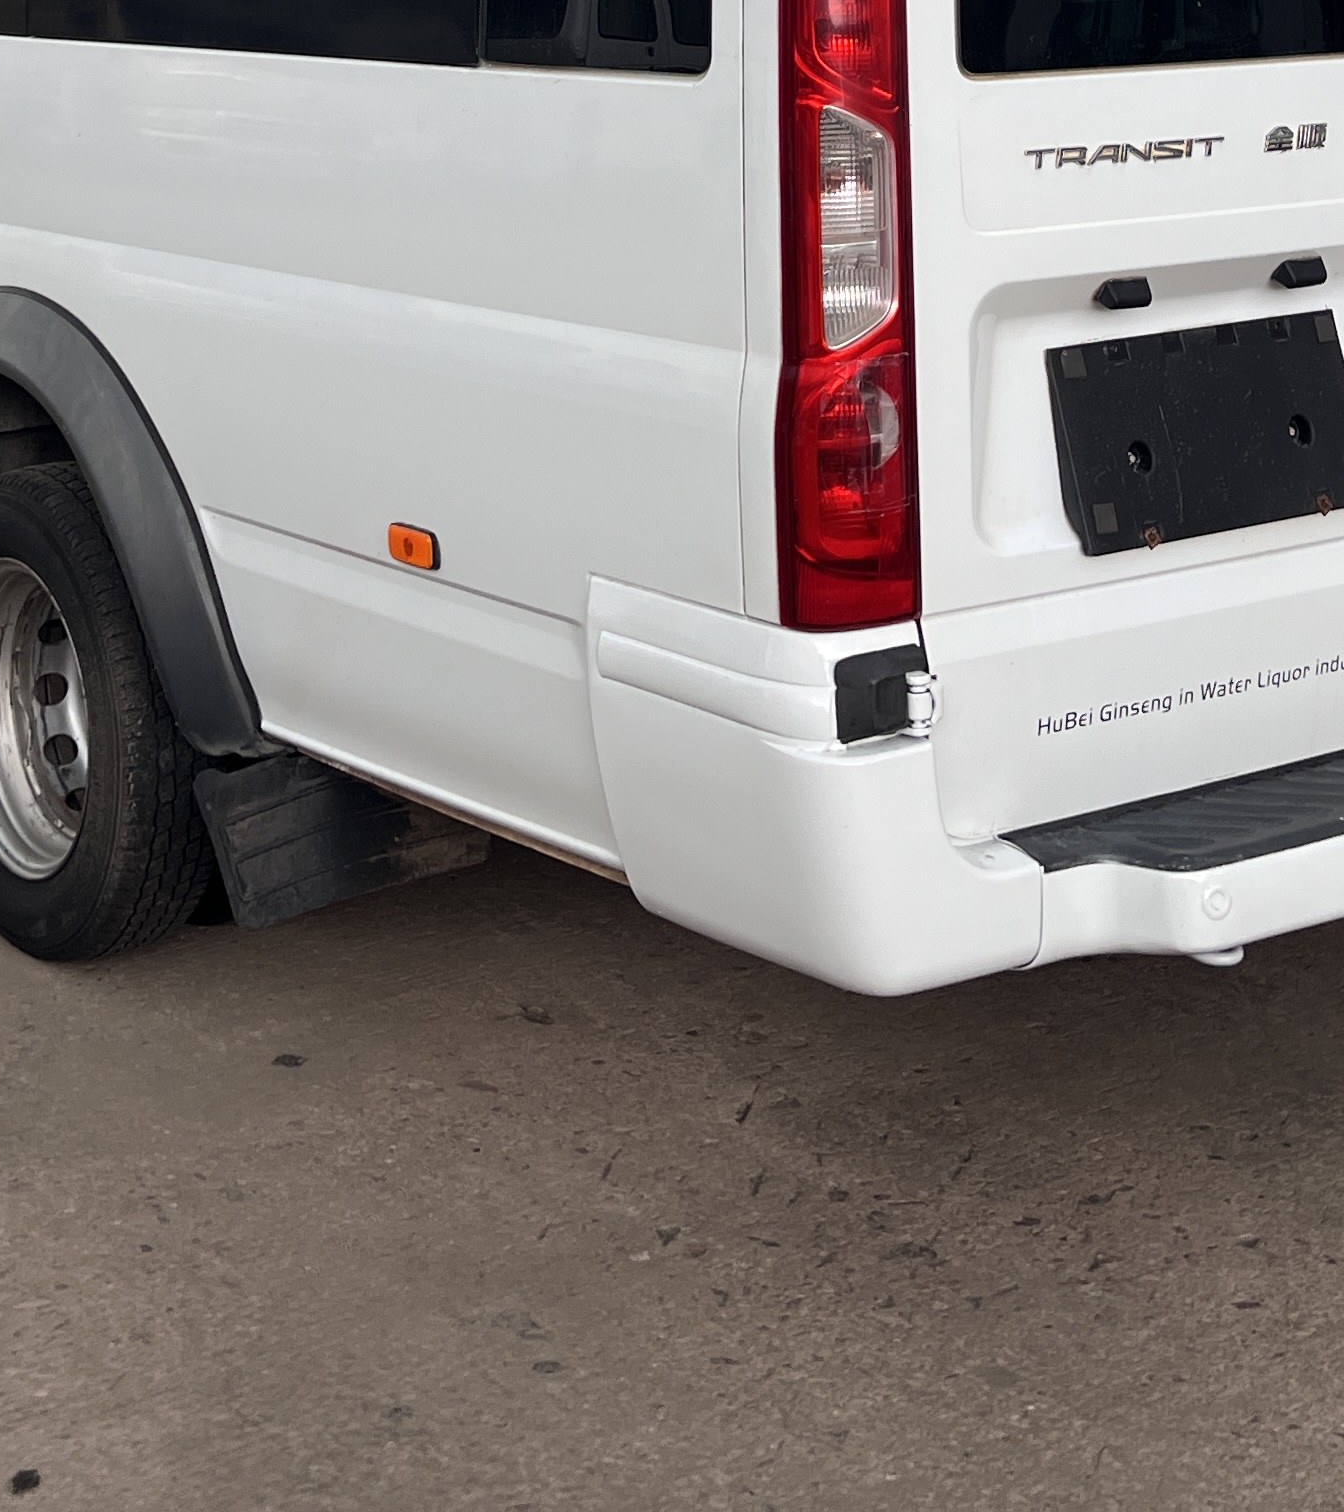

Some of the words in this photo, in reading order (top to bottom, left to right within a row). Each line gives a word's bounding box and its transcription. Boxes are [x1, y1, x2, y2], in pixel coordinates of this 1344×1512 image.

[1023, 135, 1226, 170] TRANSIT
[1037, 706, 1094, 737] HuBei
[1099, 694, 1173, 724] Ginseng
[1178, 688, 1195, 707] in
[1200, 676, 1253, 702] Water
[1257, 663, 1311, 690] Liquor
